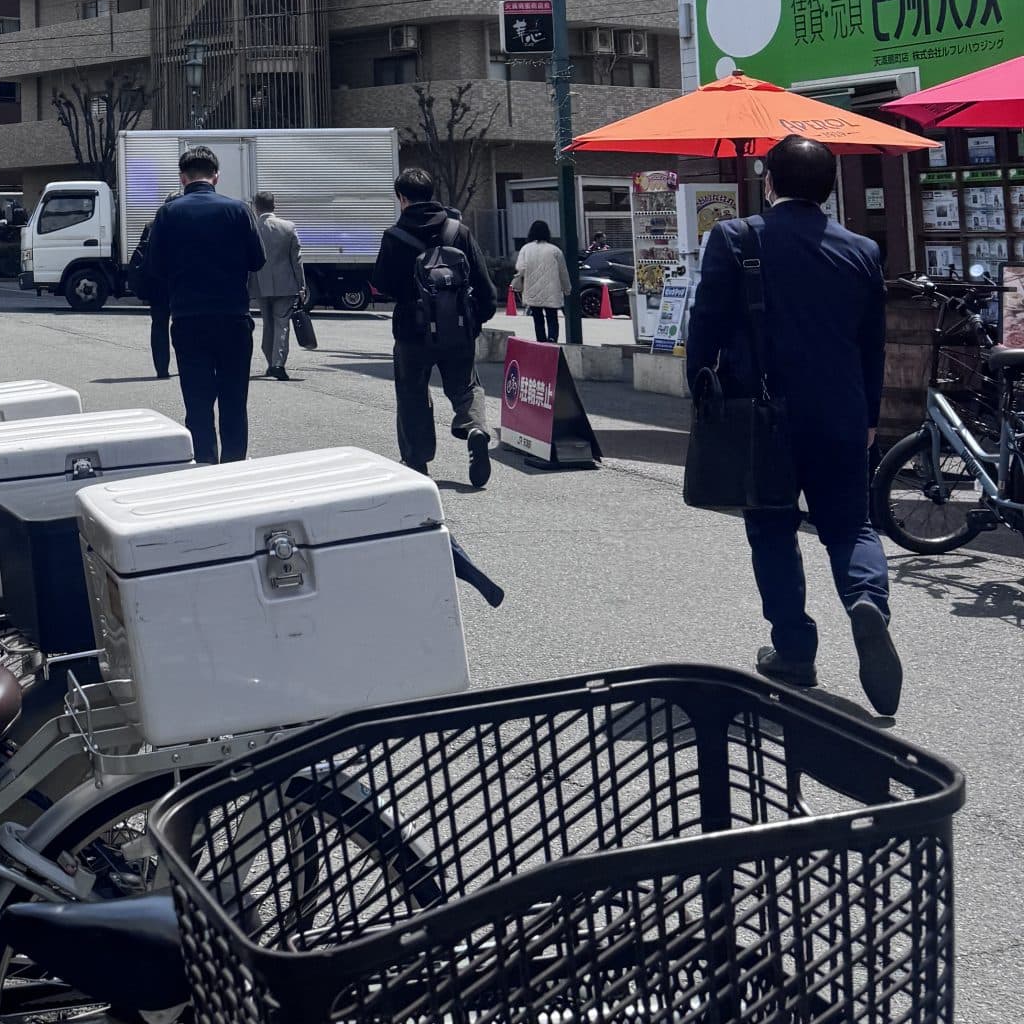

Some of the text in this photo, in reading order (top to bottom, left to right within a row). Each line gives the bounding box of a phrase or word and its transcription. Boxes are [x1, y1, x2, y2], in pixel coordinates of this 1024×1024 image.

[779, 118, 861, 133] APEROL
[520, 376, 553, 410] 駐輪禁止
